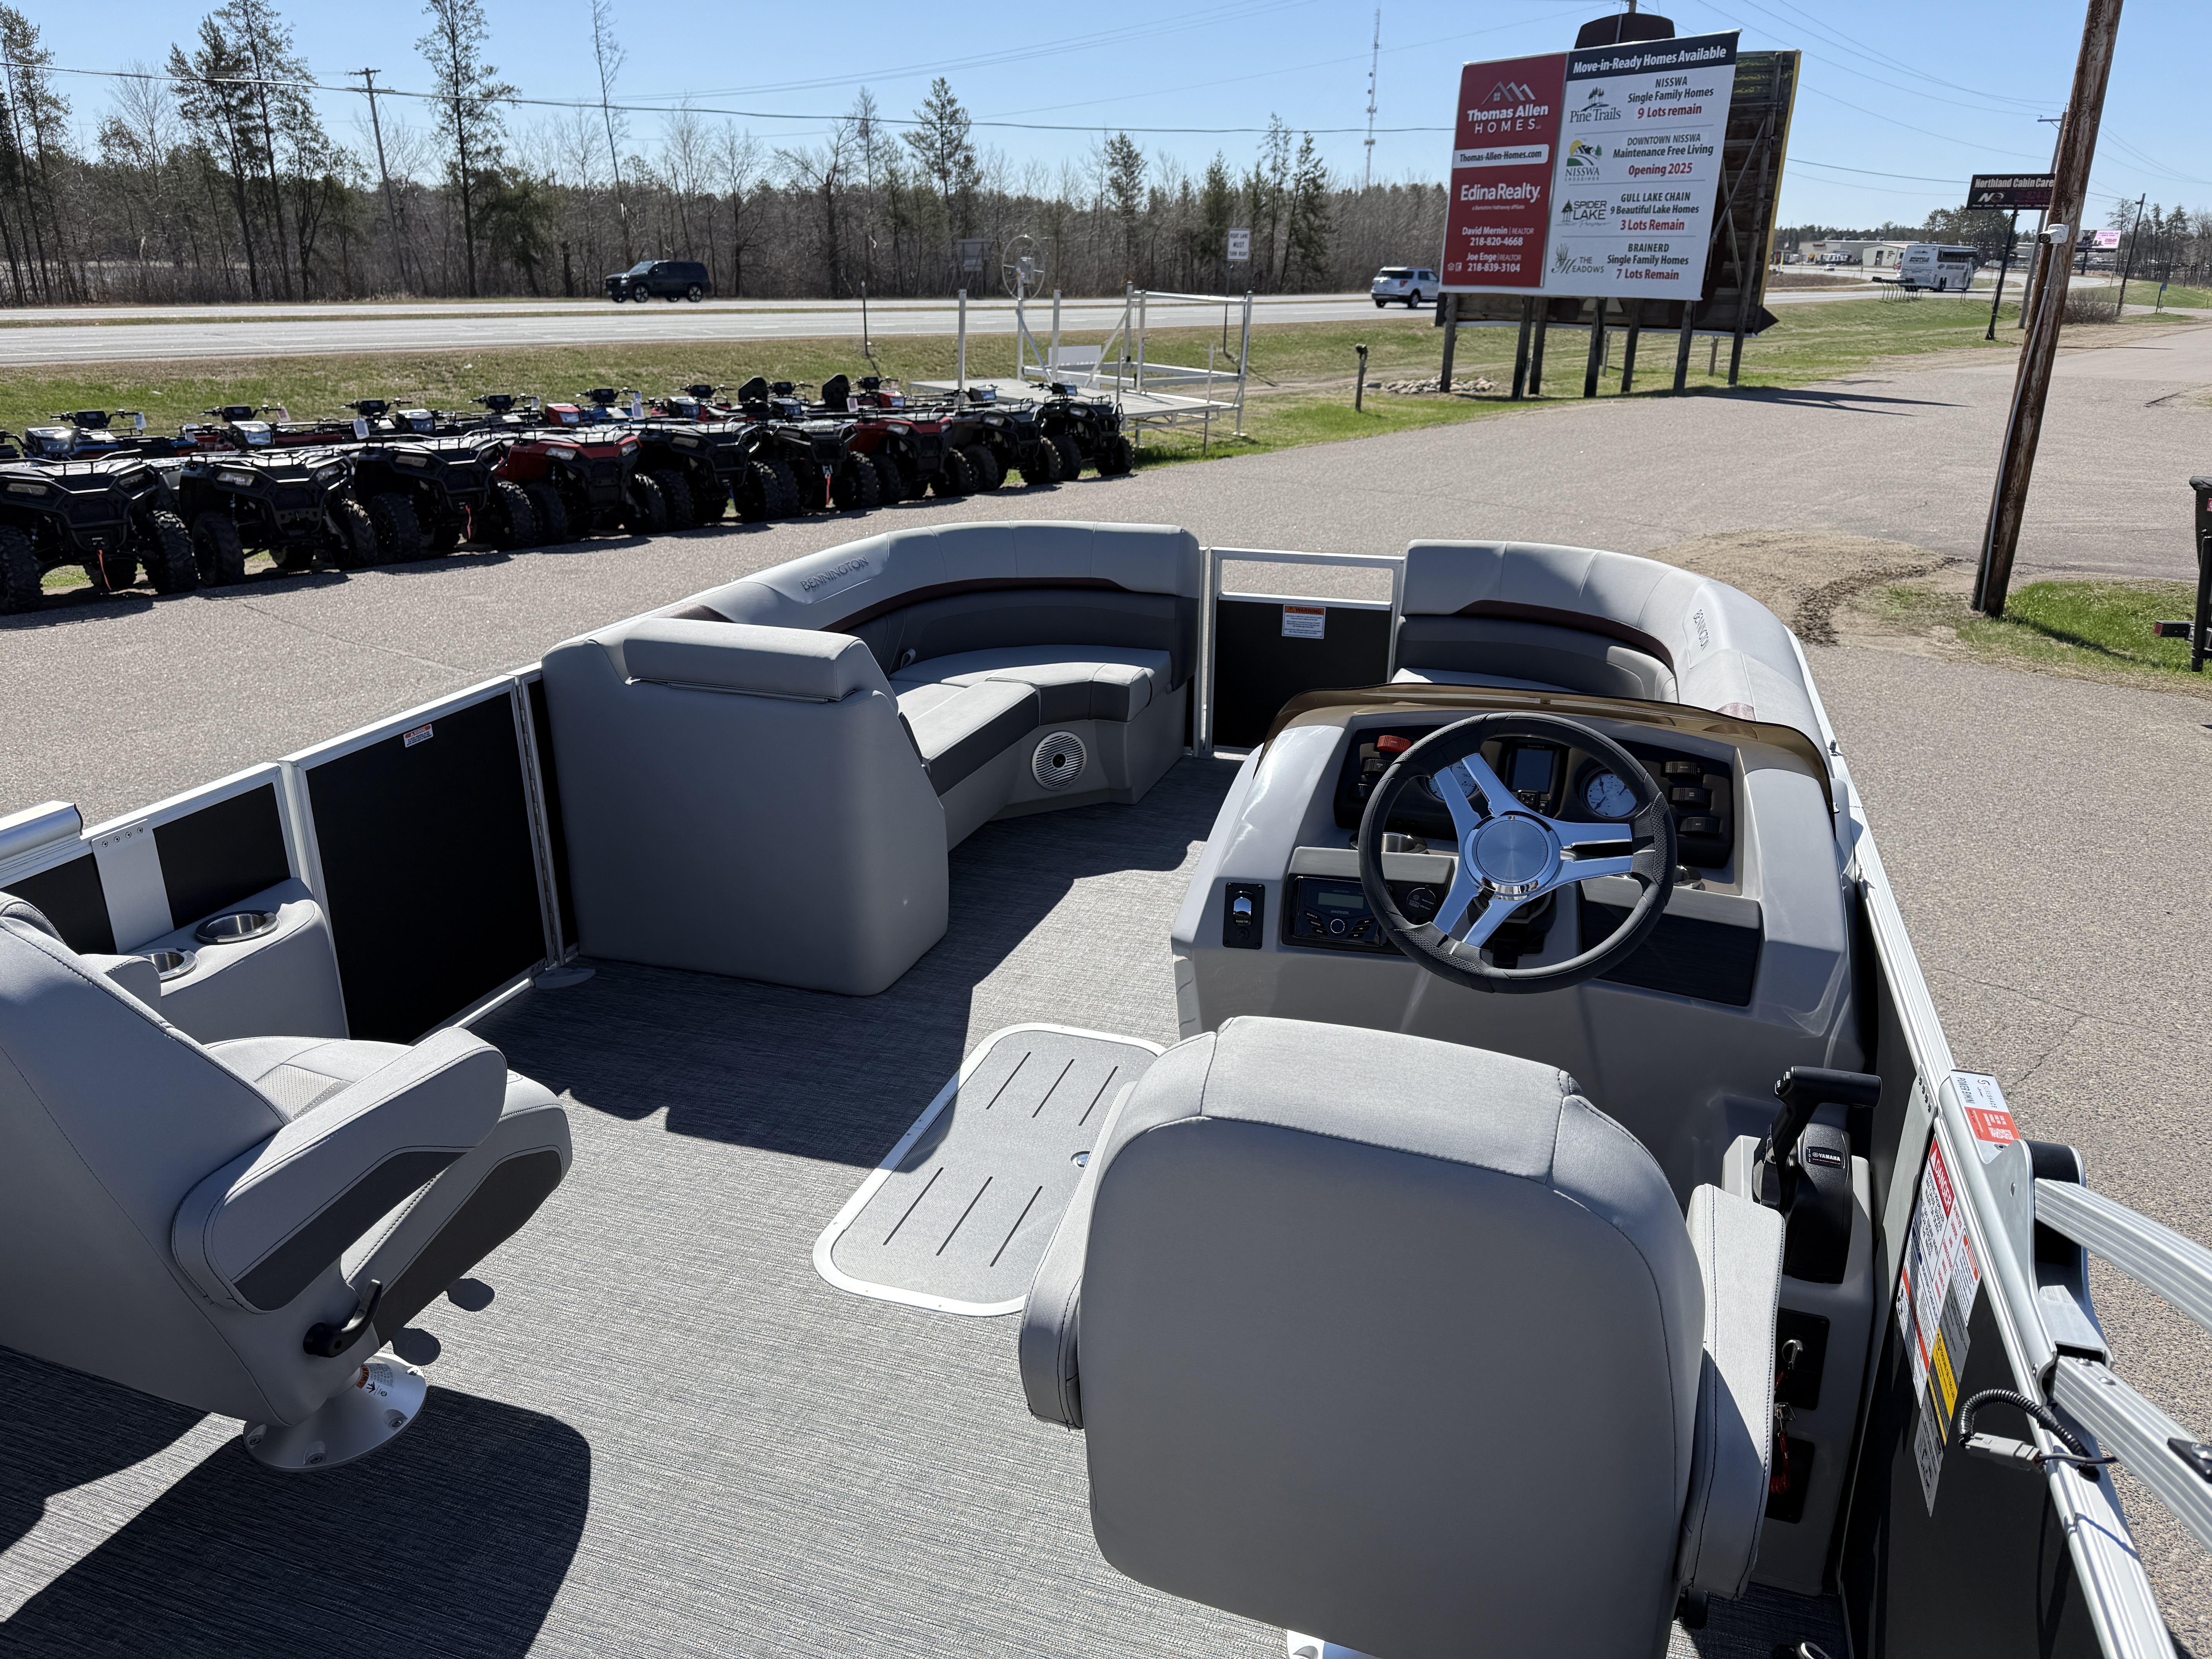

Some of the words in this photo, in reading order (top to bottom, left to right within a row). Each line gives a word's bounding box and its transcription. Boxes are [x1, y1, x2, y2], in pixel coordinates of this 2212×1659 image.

[1573, 55, 1642, 74] Move-in-Ready
[1644, 53, 1676, 67] Homes
[1678, 46, 1726, 63] Available
[1655, 76, 1687, 88] NISSWA
[1628, 93, 1653, 105] Single
[1654, 90, 1683, 101] Family
[1684, 88, 1714, 98] Homes
[1467, 109, 1513, 122] Thomas
[1515, 104, 1548, 117] Allen
[1570, 108, 1591, 123] Pine
[1592, 107, 1621, 121] Trails
[1637, 108, 1644, 119] 9
[1647, 106, 1666, 118] Lots
[1668, 104, 1702, 116] remain
[1475, 118, 1535, 134] HOMES
[1627, 135, 1670, 146] DOWNTOWN
[1673, 133, 1700, 143] NISSWA
[1460, 151, 1542, 162] Thomas-Allen-Homes.com
[1613, 148, 1665, 158] Maintenance
[1667, 146, 1685, 156] Free
[1687, 145, 1713, 156] Living
[1565, 167, 1599, 177] NISSWA
[1628, 164, 1666, 177] Opening
[1668, 163, 1692, 174] 2025
[1975, 178, 2012, 188] Northland
[2013, 178, 2035, 187] Cabin
[2035, 178, 2055, 187] Care
[1621, 193, 1640, 202] GULL
[1643, 193, 1662, 202] LAKE
[1664, 192, 1690, 201] CHAIN
[1573, 200, 1607, 209] SPIDER
[1616, 205, 1651, 214] Beautiful
[1652, 205, 1671, 214] Lake
[1672, 204, 1699, 213] Homes
[1573, 210, 1606, 220] LAKE
[1620, 220, 1626, 230] 3
[1628, 220, 1647, 230] Lots
[1649, 218, 1685, 230] Remain
[1462, 226, 1481, 235] David
[1483, 226, 1508, 235] Mernin
[1470, 237, 1523, 246] 218-820-4668
[1628, 243, 1669, 252] BRAINERD
[1467, 252, 1478, 261] Joe
[1479, 252, 1497, 263] Enge
[1607, 254, 1632, 266] Single
[1633, 255, 1659, 266] Family
[1661, 256, 1689, 265] Homes
[1467, 263, 1520, 272] 218-839-3104
[1616, 269, 1622, 279] 7
[1625, 269, 1643, 279] Lots
[1645, 269, 1679, 280] Remain
[800, 556, 869, 591] BENNINGTON
[1693, 609, 1710, 651] BENNINGTON
[1956, 1077, 1970, 1092] POWER
[1819, 1153, 1841, 1161] YAMAHA
[1935, 1158, 1952, 1212] DANGER
